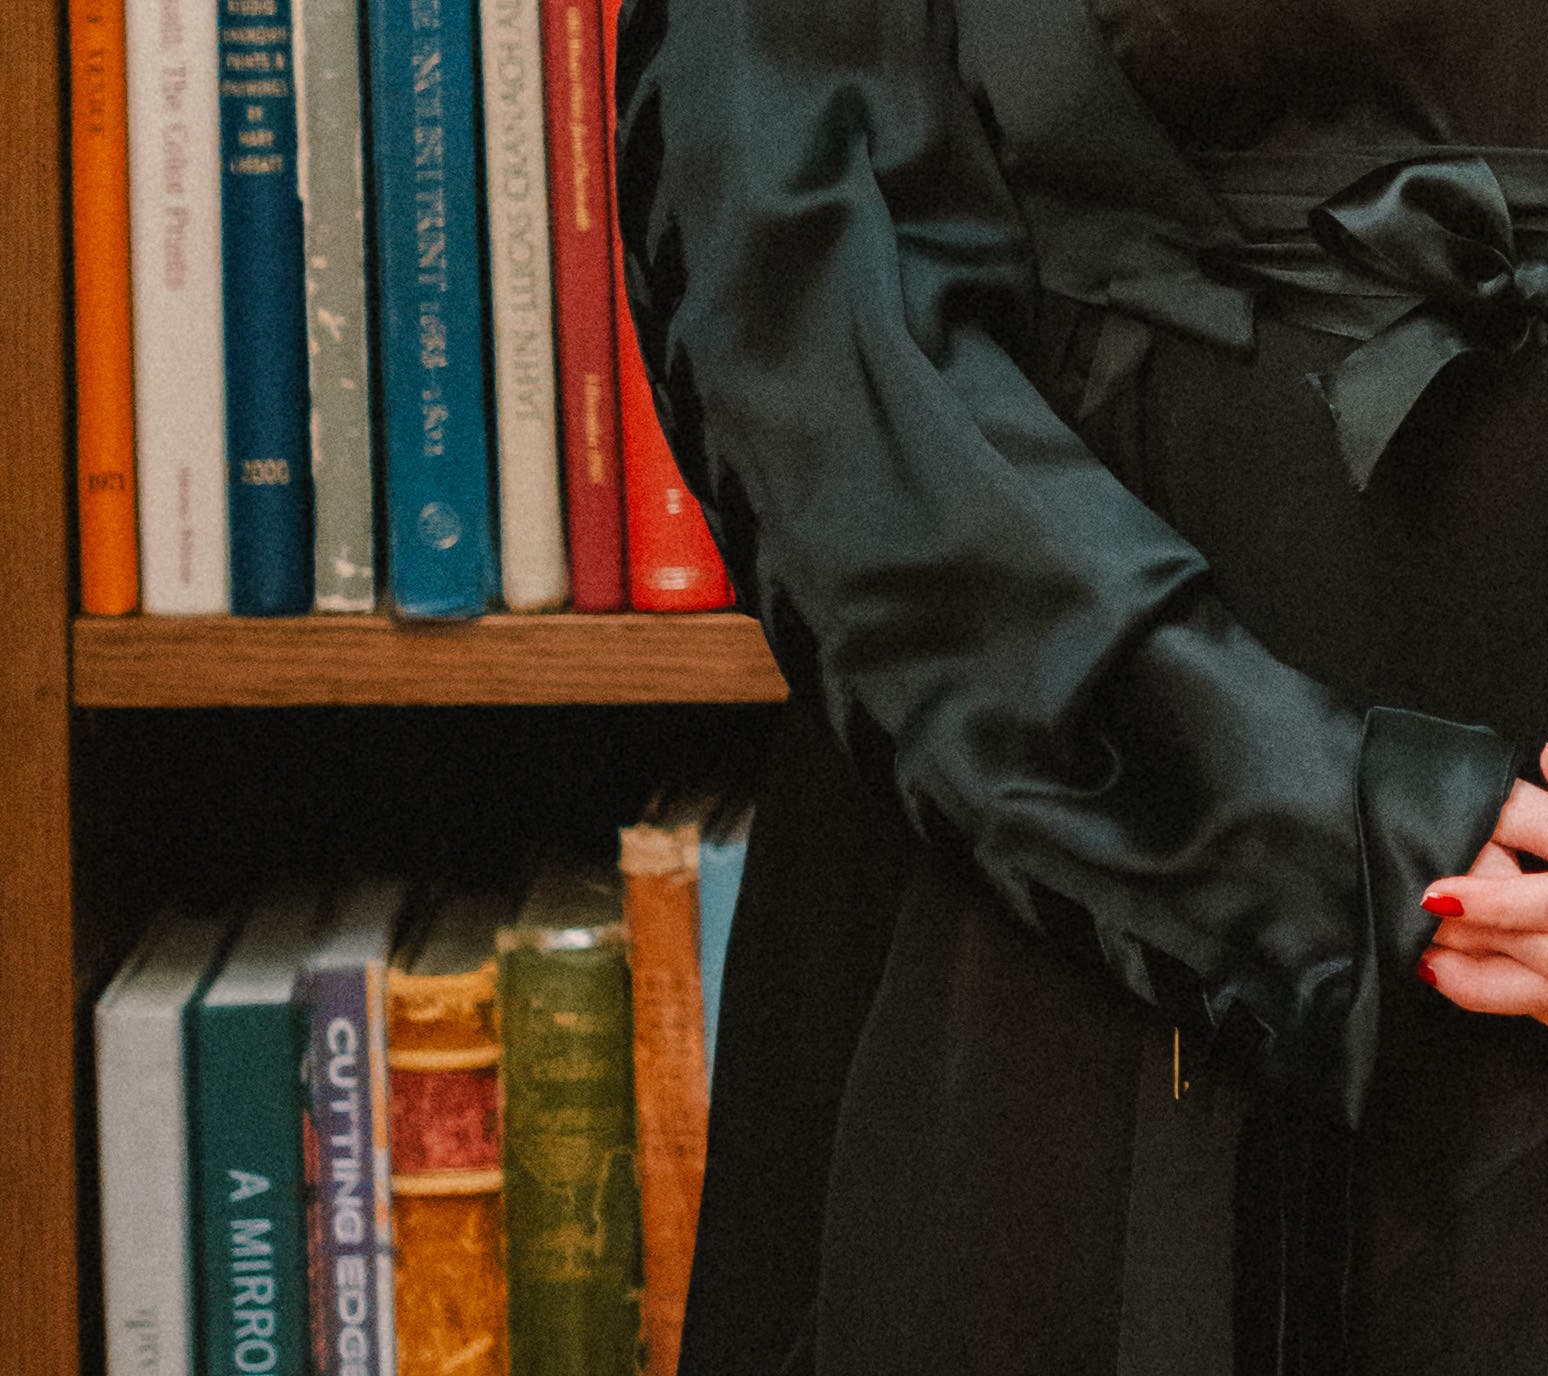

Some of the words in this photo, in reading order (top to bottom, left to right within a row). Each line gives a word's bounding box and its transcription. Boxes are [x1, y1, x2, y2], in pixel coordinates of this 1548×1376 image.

[162, 65, 188, 112] The
[163, 205, 190, 292] Prints
[326, 1015, 367, 1246] CUTTING
[227, 1169, 272, 1203] A
[229, 1218, 279, 1376] MIRRO
